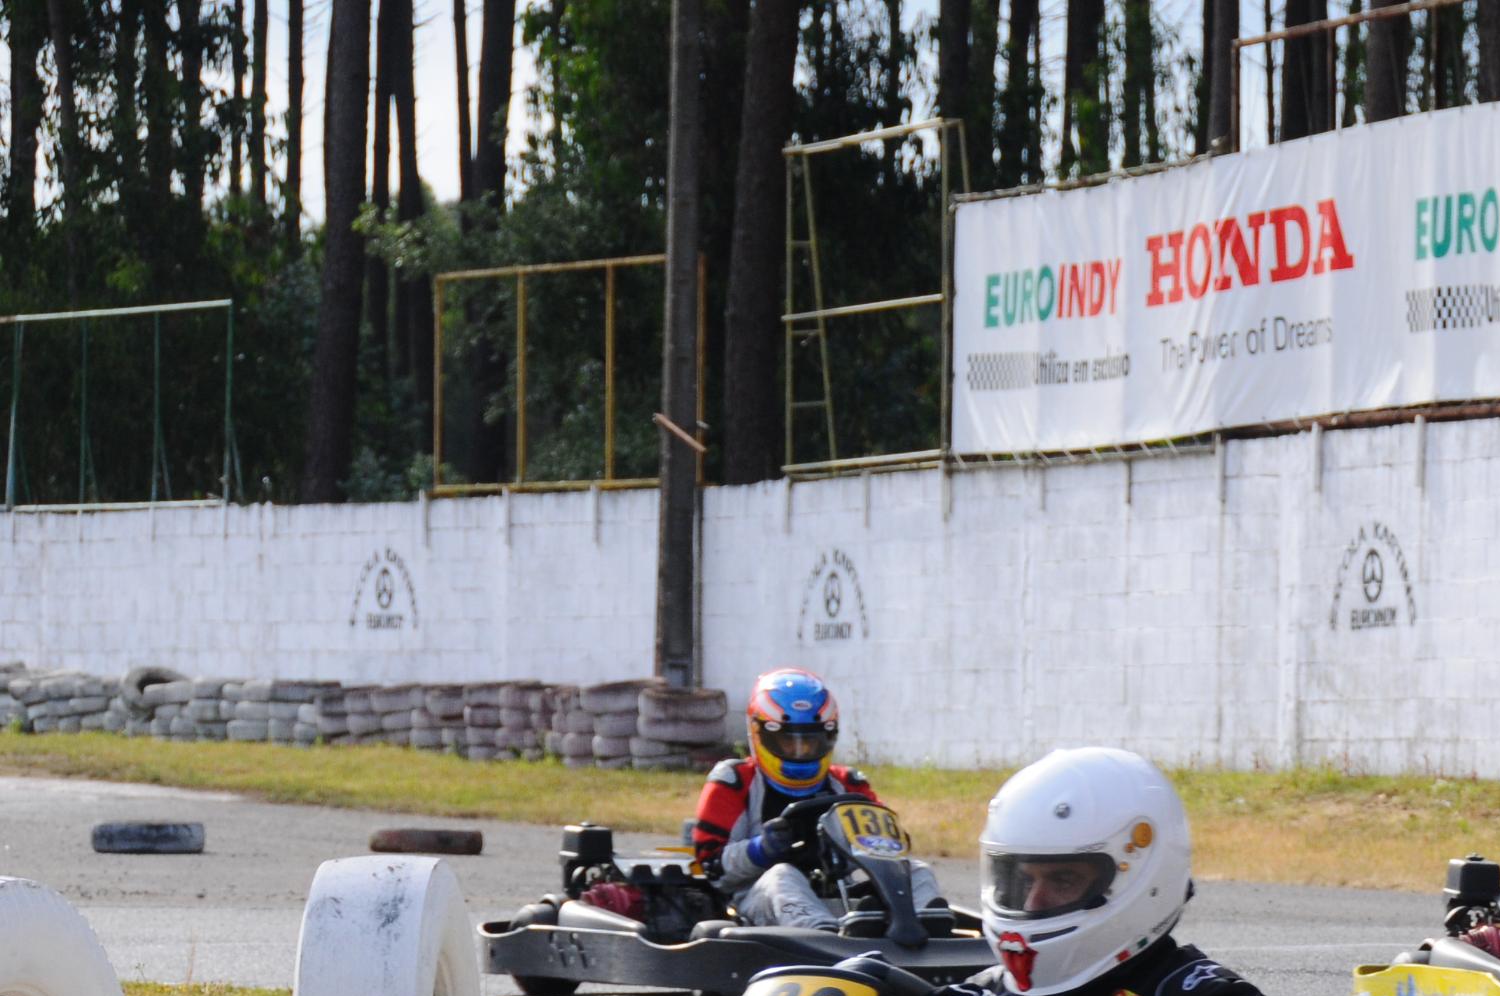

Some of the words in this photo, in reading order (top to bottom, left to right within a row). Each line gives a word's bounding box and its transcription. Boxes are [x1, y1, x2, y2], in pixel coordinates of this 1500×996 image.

[1145, 198, 1355, 308] HONDA
[983, 257, 1122, 329] EUROINDY
[1160, 336, 1185, 372] The
[1246, 321, 1267, 355] of
[1273, 315, 1334, 354] Dreams
